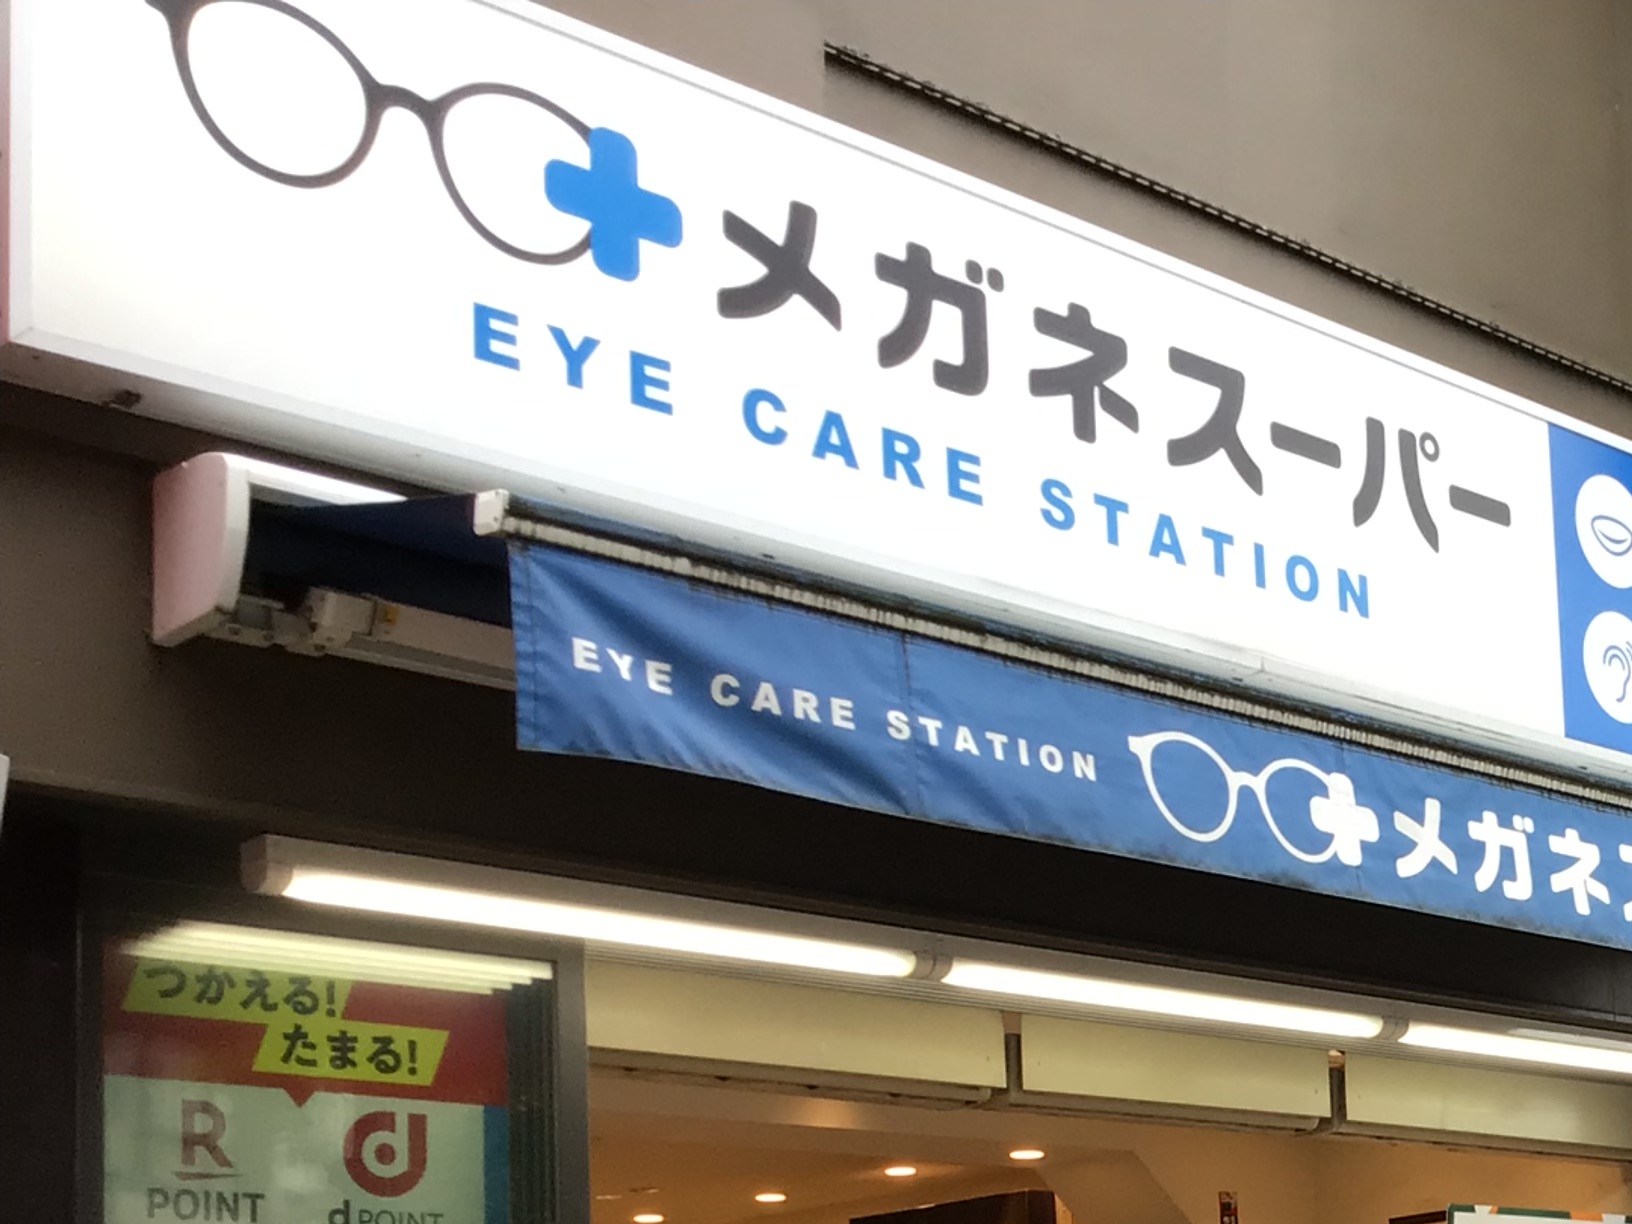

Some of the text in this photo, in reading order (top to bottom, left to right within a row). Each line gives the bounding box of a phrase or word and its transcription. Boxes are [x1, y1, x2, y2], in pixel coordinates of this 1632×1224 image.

[716, 200, 1512, 554] メガネスーパー
[472, 302, 1370, 619] EYE CARE STATION
[572, 637, 1098, 782] EYE CARE STATION
[144, 964, 338, 1019] つかえる!
[280, 1023, 419, 1076] たまる!
[146, 1186, 266, 1224] POINT
